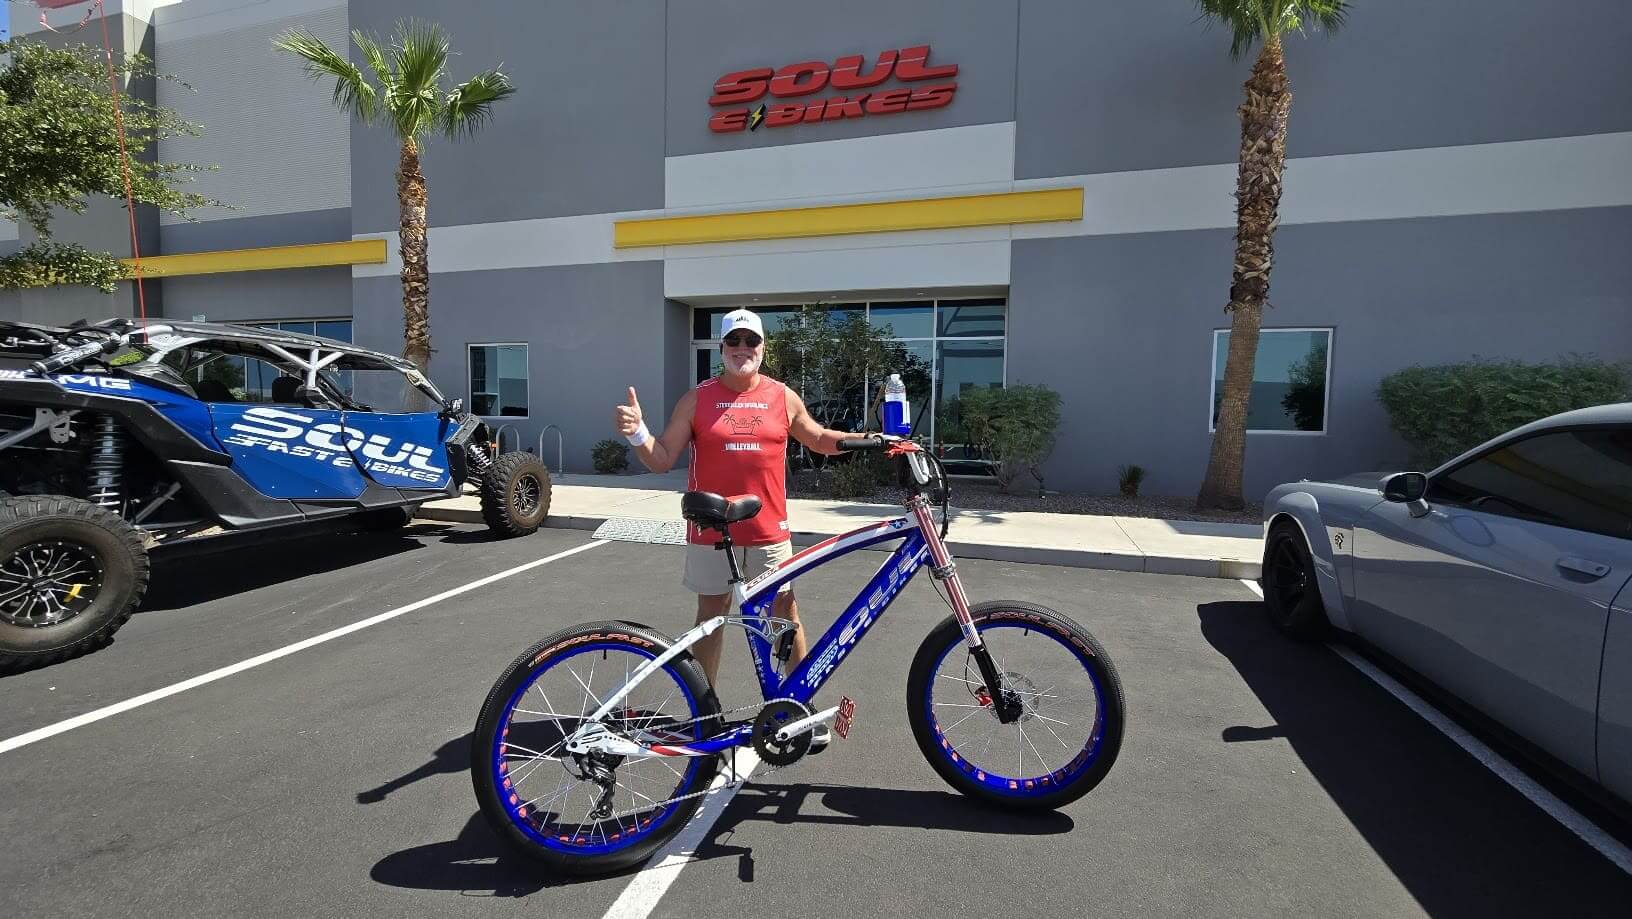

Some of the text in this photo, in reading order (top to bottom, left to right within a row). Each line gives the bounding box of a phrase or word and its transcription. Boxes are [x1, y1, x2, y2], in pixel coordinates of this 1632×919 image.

[708, 45, 958, 107] SOUL
[223, 433, 334, 461] FAST
[230, 407, 444, 474] SOUL
[806, 544, 928, 688] SOUL
